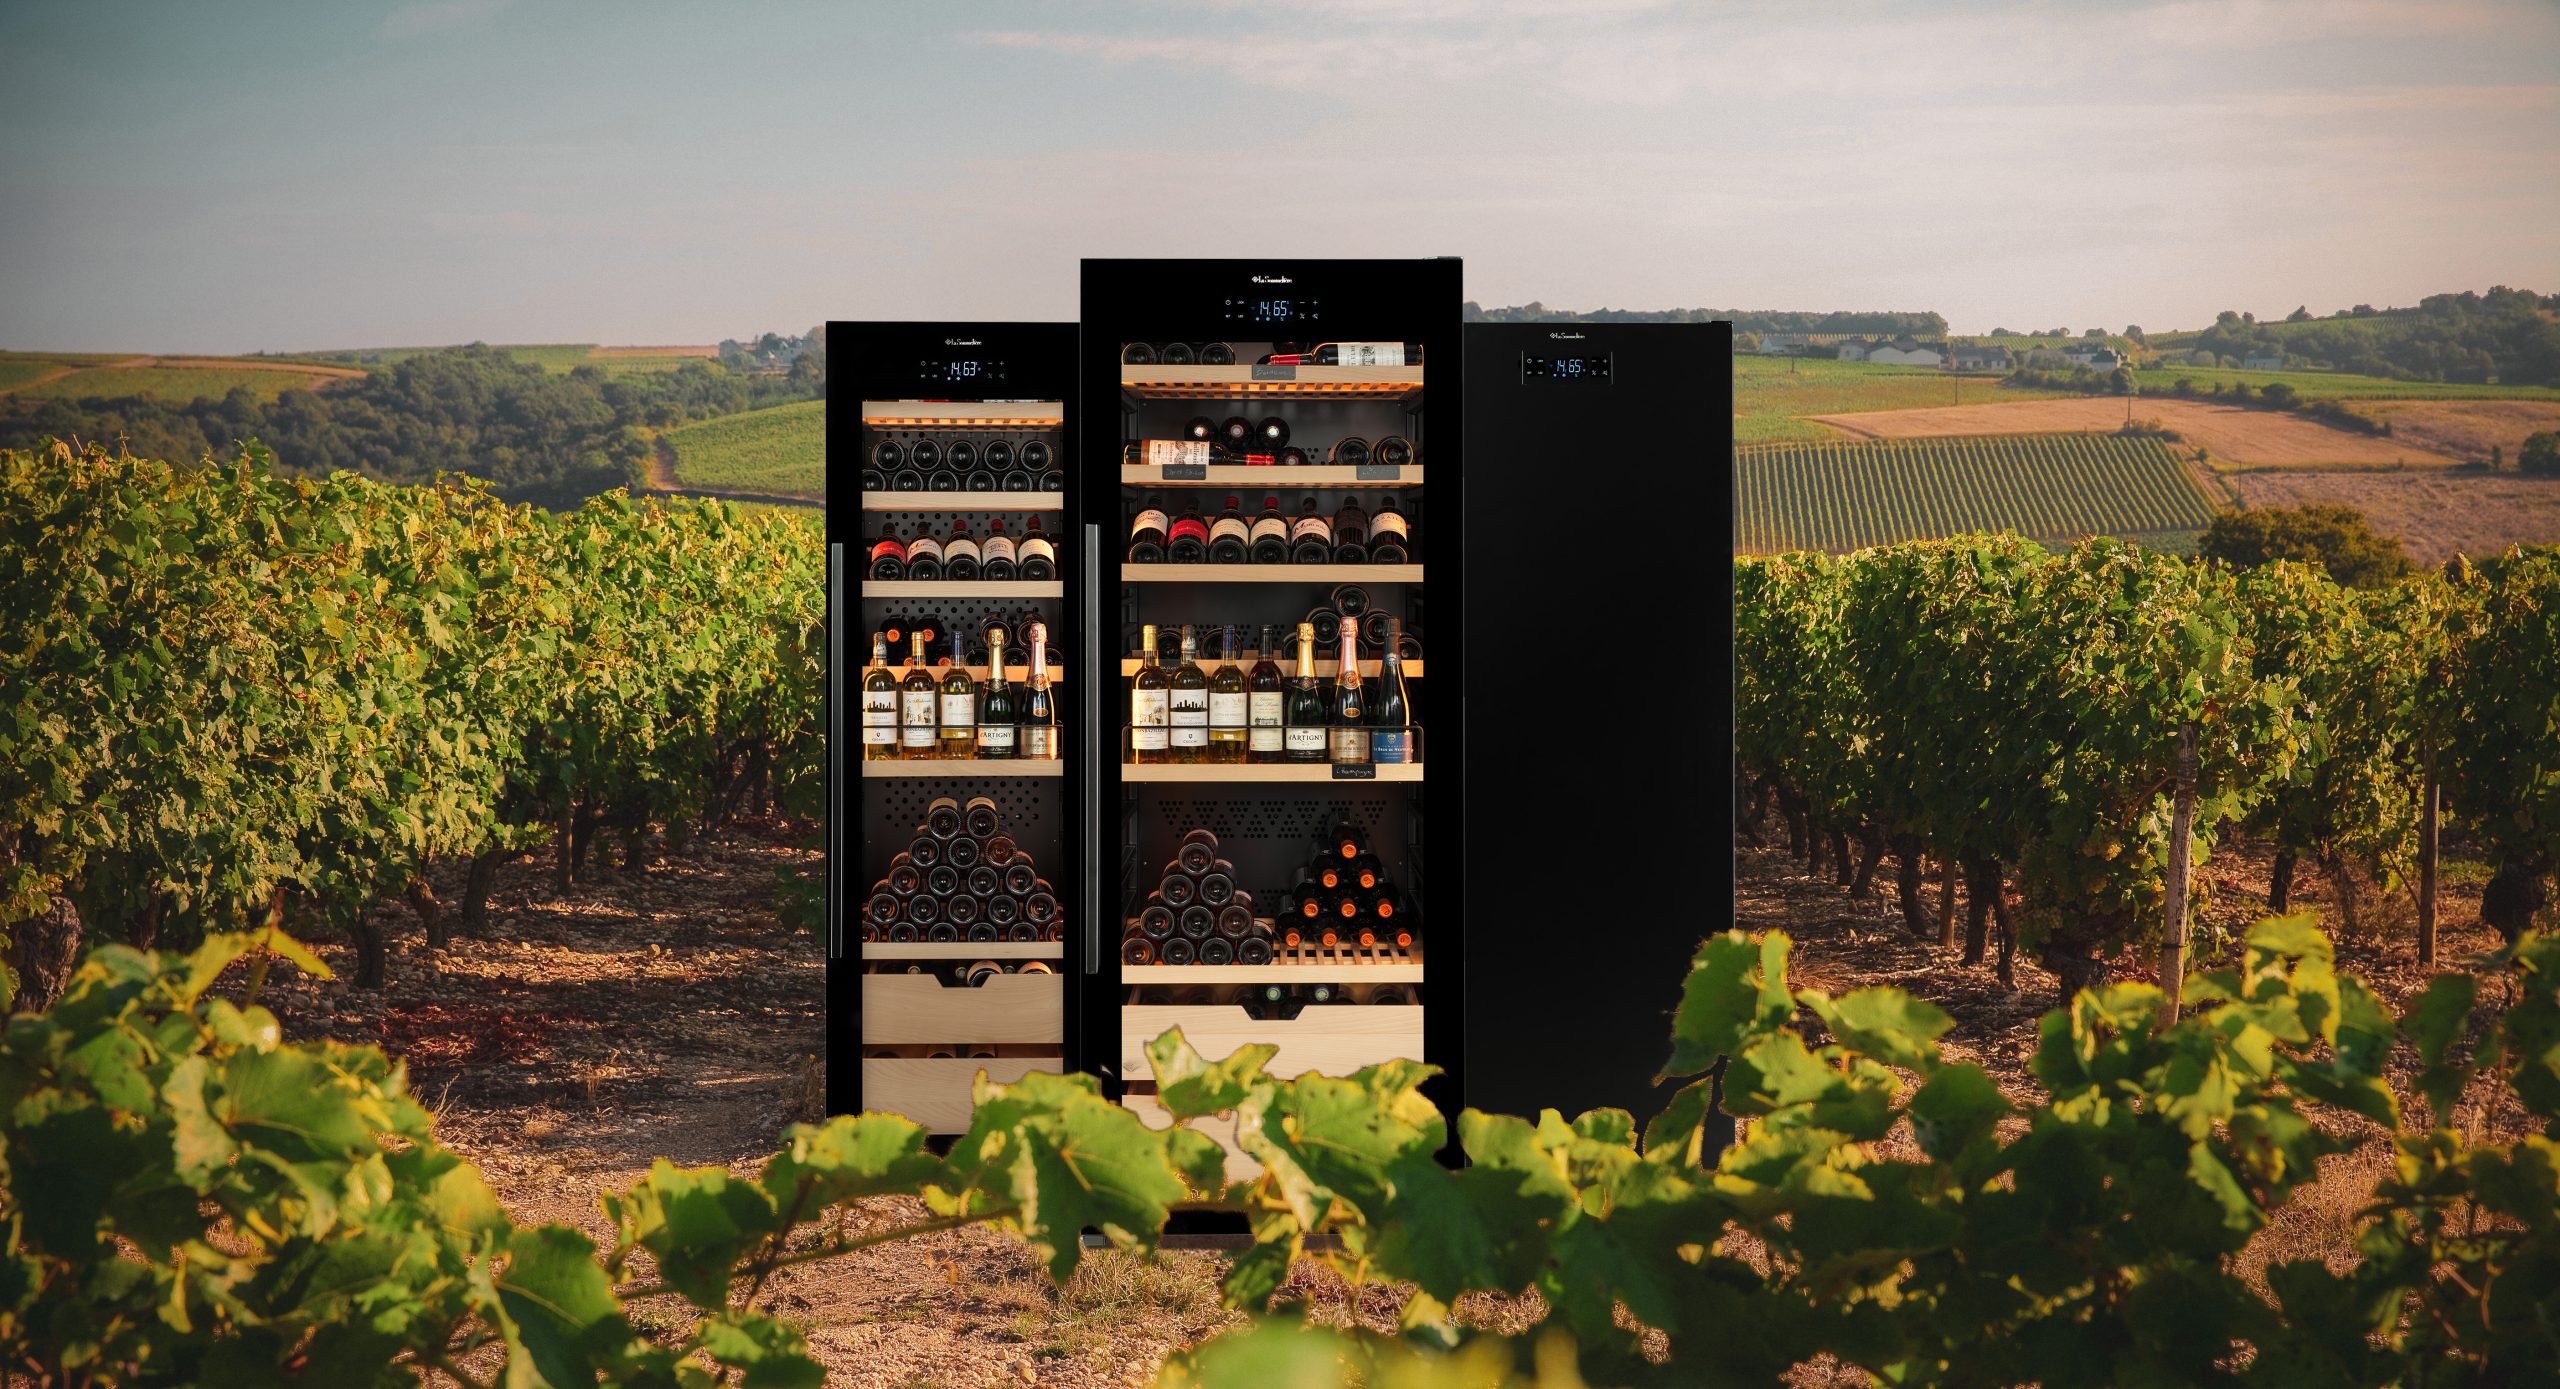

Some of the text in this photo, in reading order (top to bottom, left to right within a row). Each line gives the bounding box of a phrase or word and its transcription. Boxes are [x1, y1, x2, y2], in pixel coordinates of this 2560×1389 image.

[1260, 301, 1287, 316] 14 65
[951, 362, 976, 376] 14 63
[1557, 359, 1580, 373] 14 65
